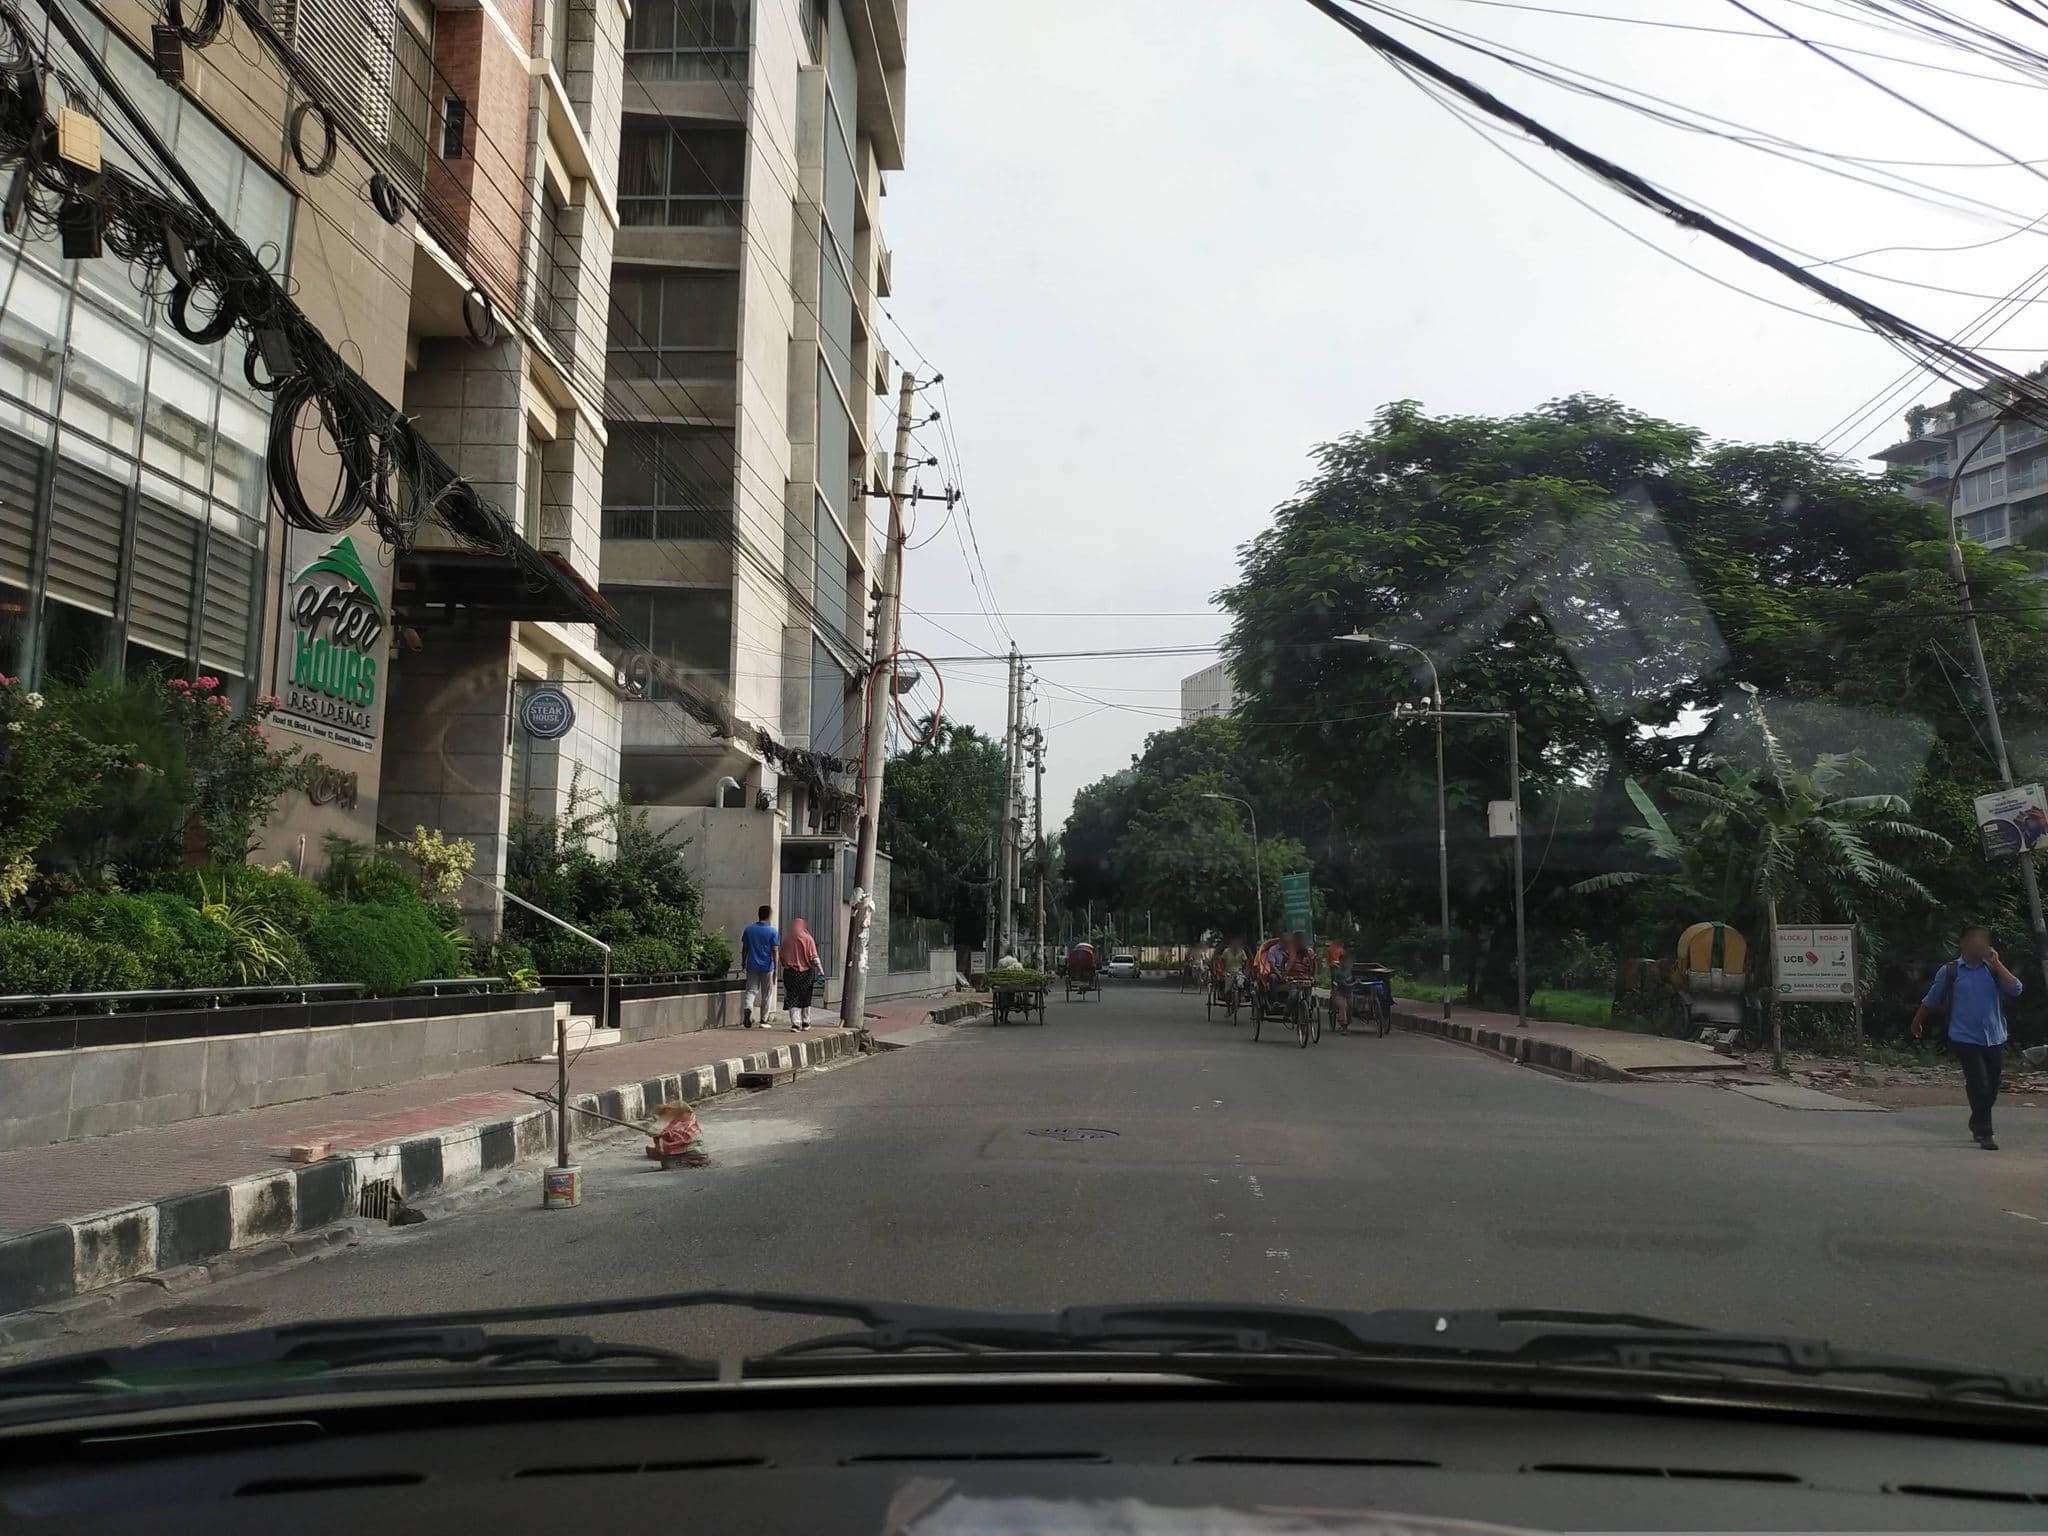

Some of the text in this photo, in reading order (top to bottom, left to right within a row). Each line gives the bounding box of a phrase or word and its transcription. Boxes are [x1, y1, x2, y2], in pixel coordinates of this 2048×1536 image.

[291, 630, 377, 706] HOURS
[287, 691, 371, 728] RESIDENCE
[530, 706, 562, 715] STEAK
[272, 715, 286, 724] Road
[532, 714, 560, 722] HOUSE
[1783, 955, 1804, 963] UCB
